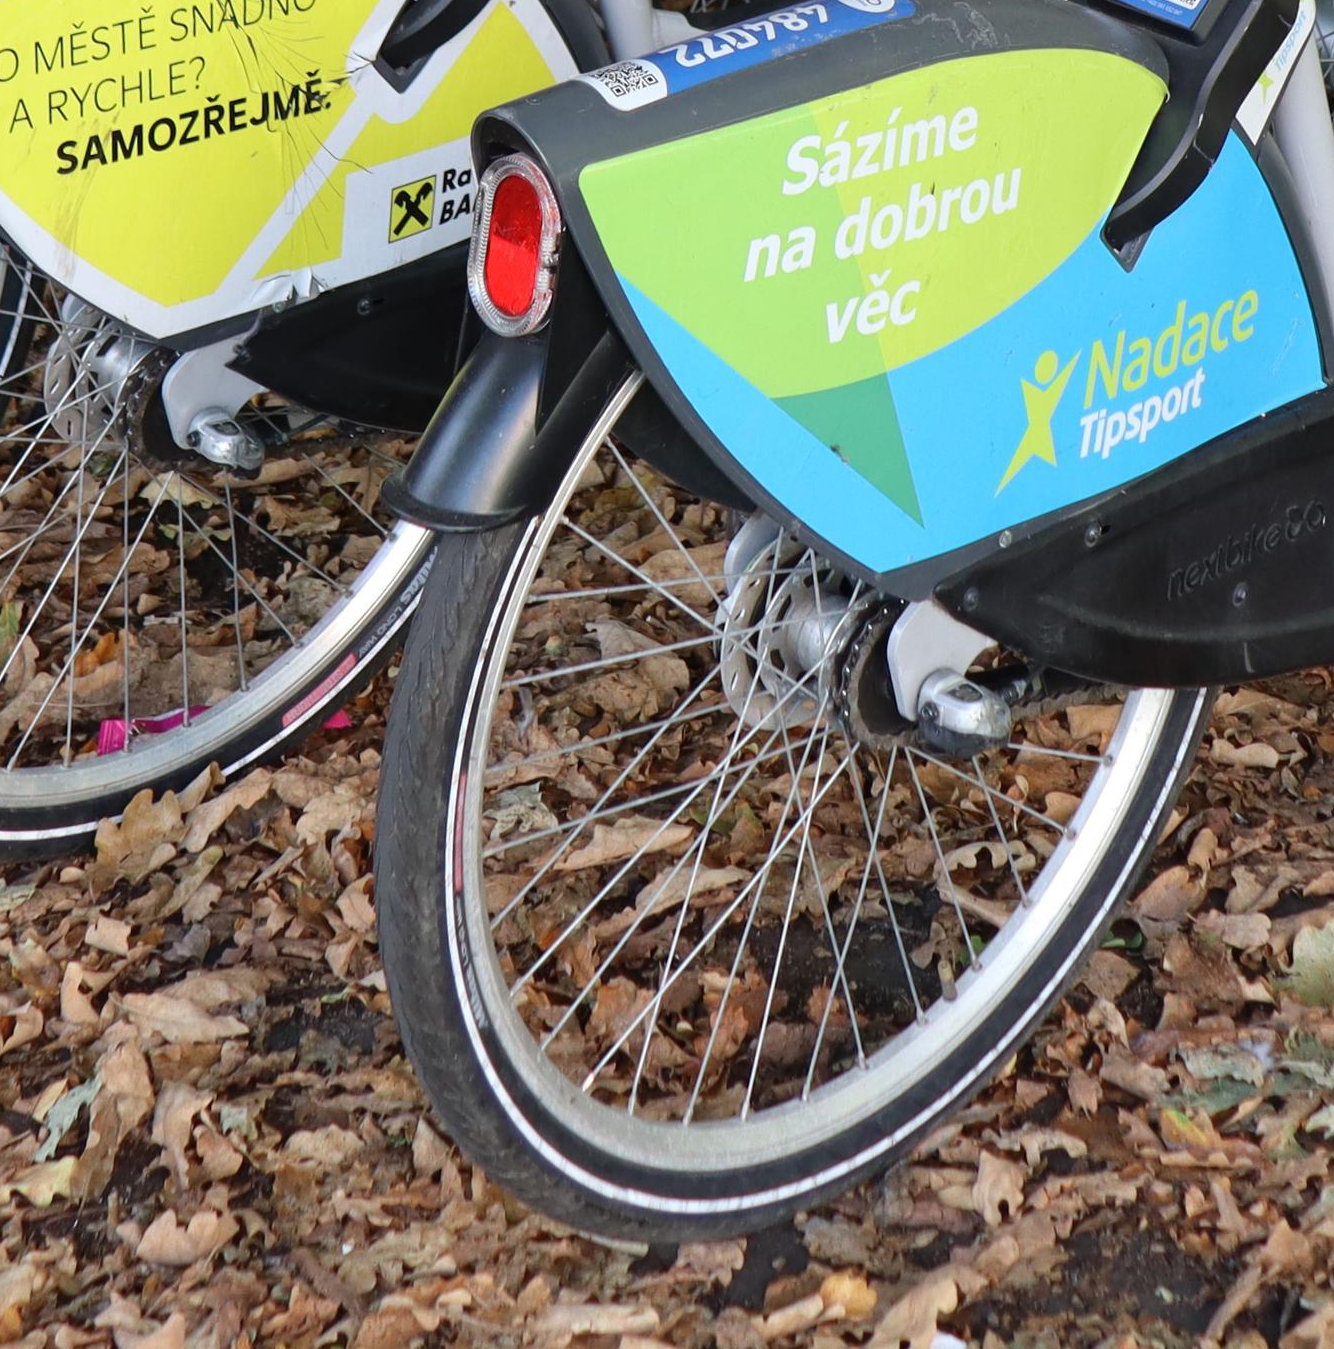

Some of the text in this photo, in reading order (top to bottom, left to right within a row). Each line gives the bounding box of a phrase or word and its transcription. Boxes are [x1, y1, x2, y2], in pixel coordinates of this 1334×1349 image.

[34, 4, 157, 75] MĚSTĚ
[659, 3, 831, 69] 484072
[9, 55, 207, 134] A RYCHLE?
[55, 68, 332, 175] SAMOZŘEJMĚ.
[441, 167, 472, 194] Ra
[781, 104, 978, 196] Sázíme
[743, 167, 1022, 282] na dobrou
[825, 270, 921, 344] věc
[1083, 289, 1259, 409] Nadace
[1079, 367, 1206, 460] Tipsport
[1167, 522, 1282, 601] nextbike
